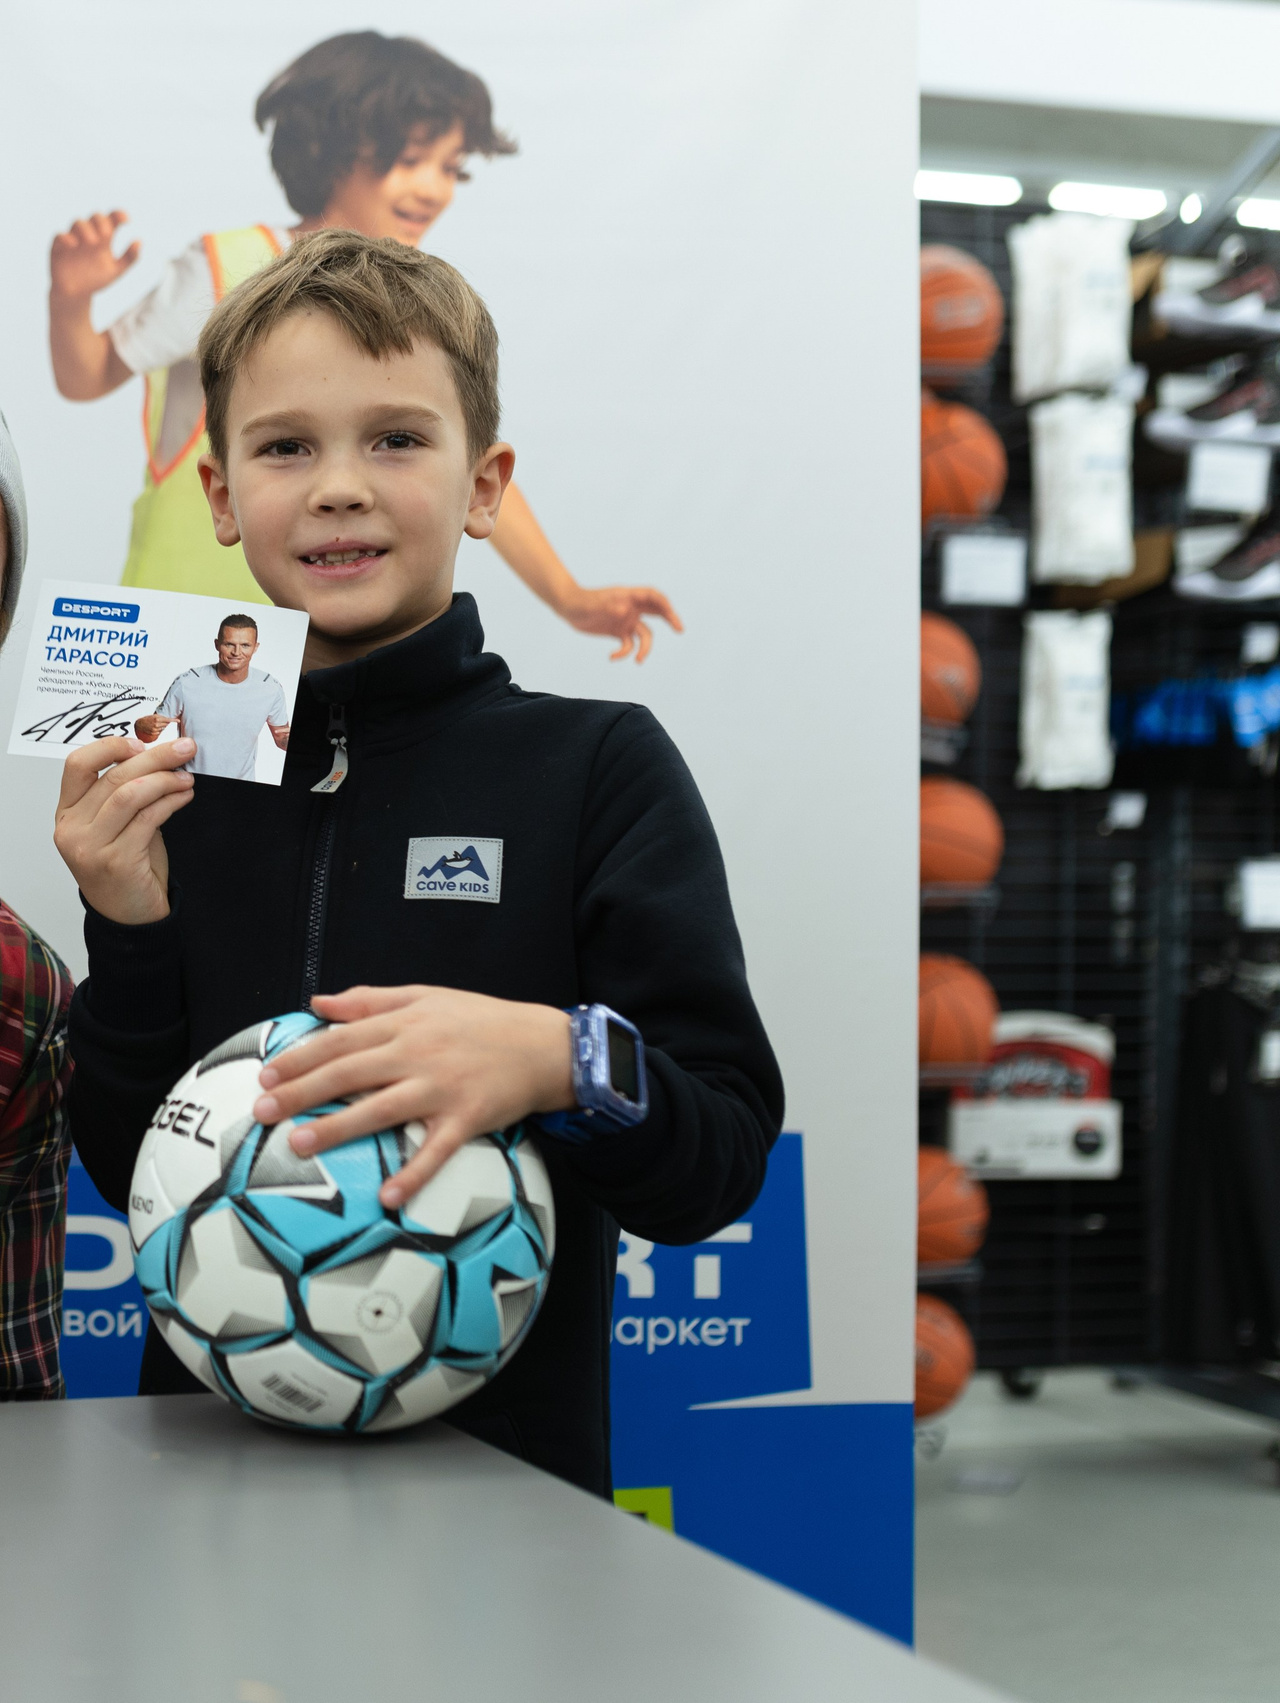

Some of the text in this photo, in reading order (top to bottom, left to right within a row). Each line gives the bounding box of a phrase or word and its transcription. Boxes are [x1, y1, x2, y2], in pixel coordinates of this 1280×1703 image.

[61, 602, 131, 618] DESPORT
[46, 625, 149, 648] ДМИТРИЙ
[45, 646, 139, 668] ТАРАСОВ
[459, 882, 489, 893] KIDS
[62, 1302, 752, 1355] вой аркет
